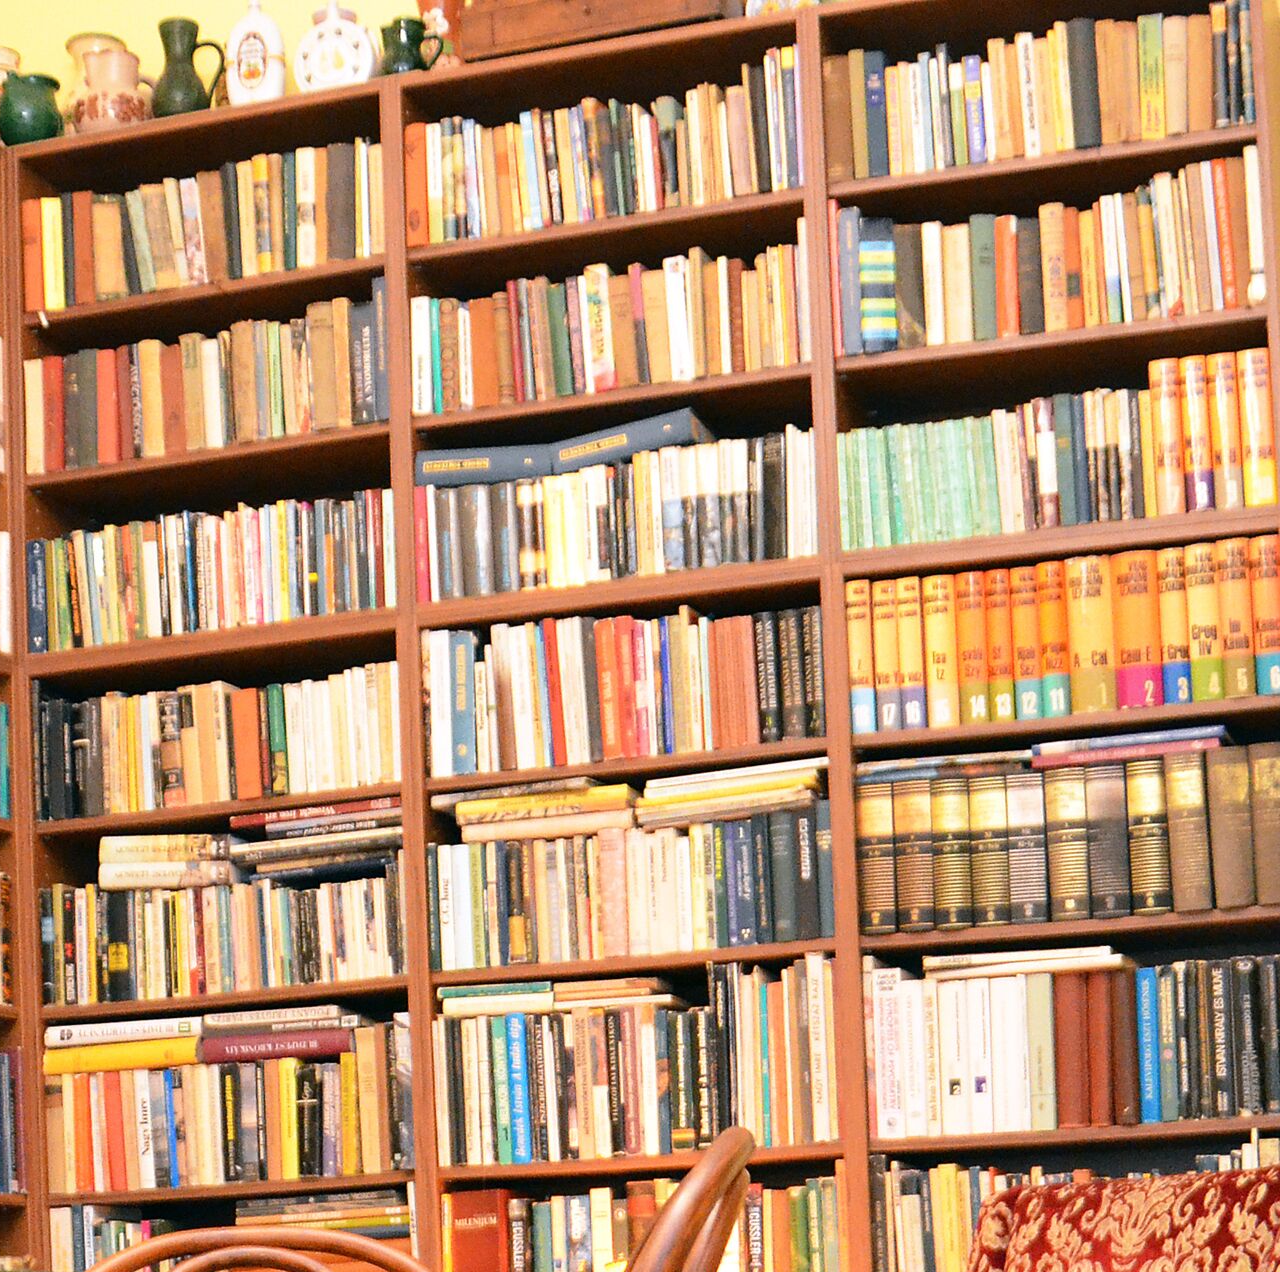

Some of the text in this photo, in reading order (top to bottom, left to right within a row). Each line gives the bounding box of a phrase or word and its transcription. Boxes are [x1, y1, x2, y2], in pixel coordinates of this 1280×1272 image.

[1177, 676, 1189, 700] 3
[1208, 670, 1220, 695] 4
[1236, 667, 1248, 691] 5
[1021, 690, 1037, 715] 12
[1048, 687, 1064, 712] 11
[1099, 681, 1108, 706] 1
[1144, 680, 1155, 707] 2
[508, 1017, 522, 1039] útja
[275, 1039, 318, 1051] BUDAPEST
[509, 1041, 522, 1070] tudás
[511, 1084, 524, 1114] István
[814, 1078, 823, 1104] NAGY
[139, 1098, 154, 1155] Nagy Imre
[513, 1117, 526, 1157] Benedek
[749, 1212, 761, 1255] CUSSLER
[512, 1226, 524, 1269] CUSSLER
